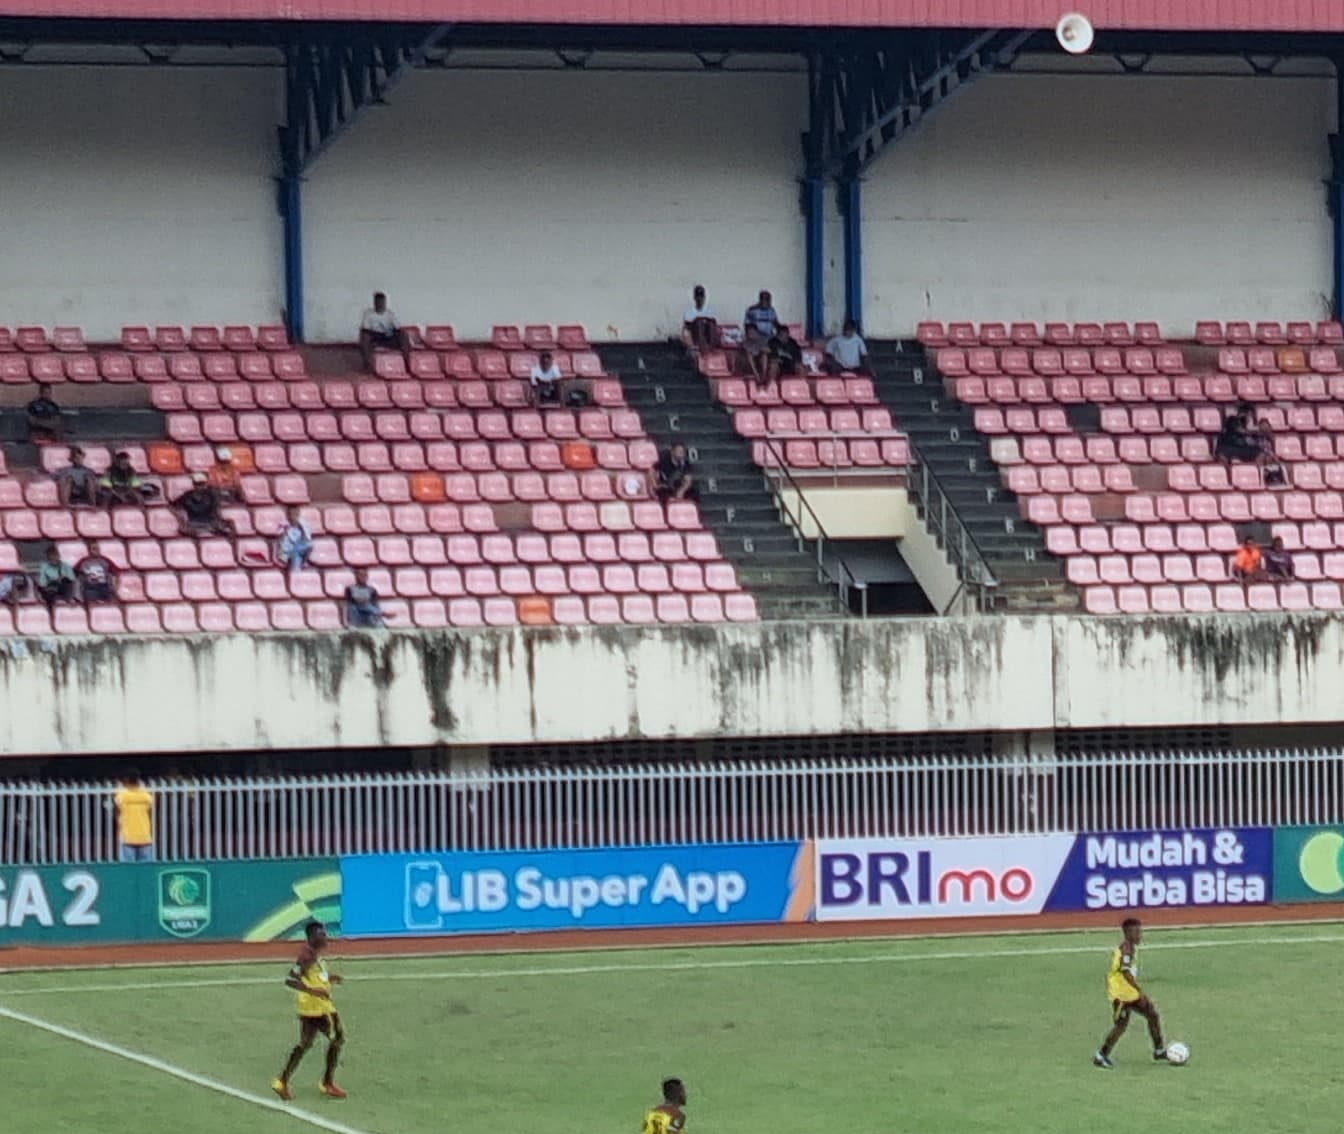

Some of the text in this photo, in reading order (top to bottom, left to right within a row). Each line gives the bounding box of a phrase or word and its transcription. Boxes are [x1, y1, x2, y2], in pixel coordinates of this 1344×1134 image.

[1086, 831, 1244, 868] Mudah &
[0, 869, 100, 928] A 2
[438, 863, 747, 919] LIB Super App
[820, 849, 1033, 907] BRImo
[1086, 870, 1265, 908] Serba Bisa
